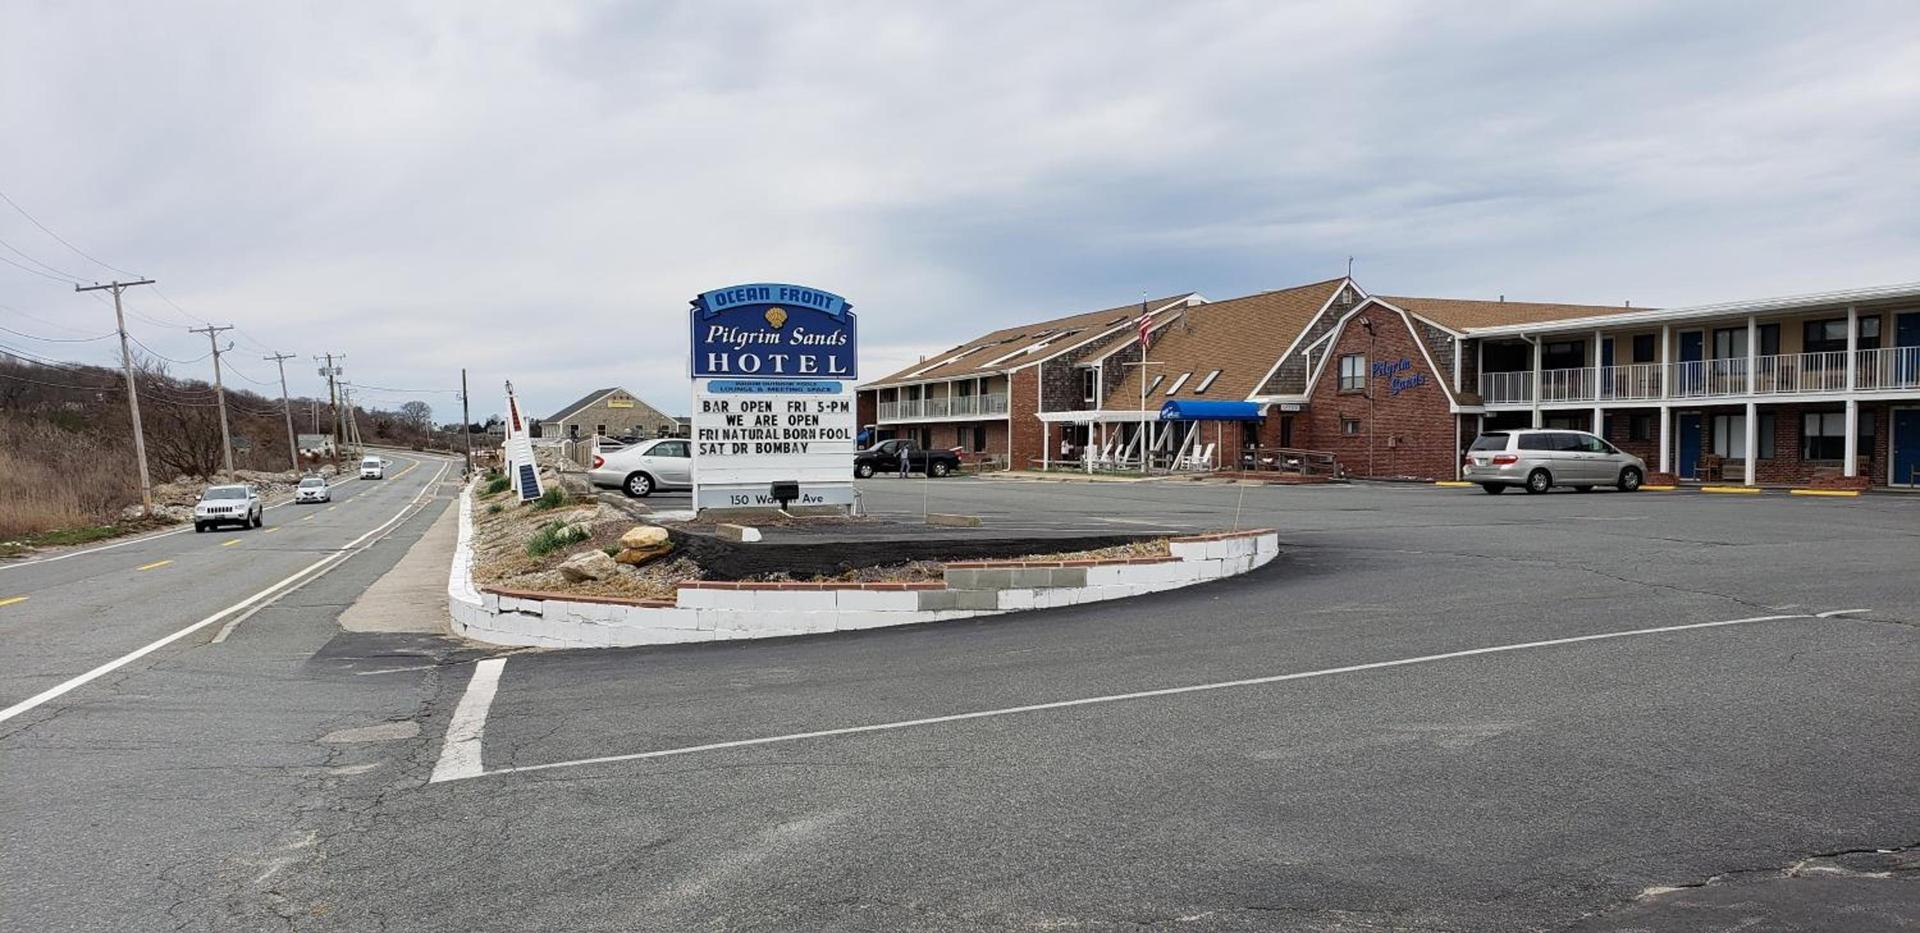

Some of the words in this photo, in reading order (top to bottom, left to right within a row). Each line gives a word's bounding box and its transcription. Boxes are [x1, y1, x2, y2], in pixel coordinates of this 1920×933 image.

[714, 287, 770, 307] OCEAN
[779, 287, 835, 310] FRONT
[705, 325, 781, 350] Pilgrim
[789, 327, 848, 346] Sands
[707, 352, 848, 374] HOTEL
[1372, 359, 1411, 377] Pilgrim
[703, 400, 730, 413] BAR
[740, 400, 773, 412] OPEN
[787, 401, 808, 412] FRI
[817, 401, 850, 412] 5-PM
[726, 415, 744, 426] WE
[754, 415, 779, 426] ARE
[788, 415, 819, 426] OPEN
[699, 428, 719, 441] FRI
[722, 429, 780, 440] NATURAL
[783, 429, 817, 440] BORN
[819, 429, 851, 440] FOOL
[700, 443, 726, 455] SAT
[732, 443, 749, 454] DR
[755, 442, 809, 454] BOMBAY
[730, 495, 750, 505] 150
[802, 493, 825, 503] Ave
